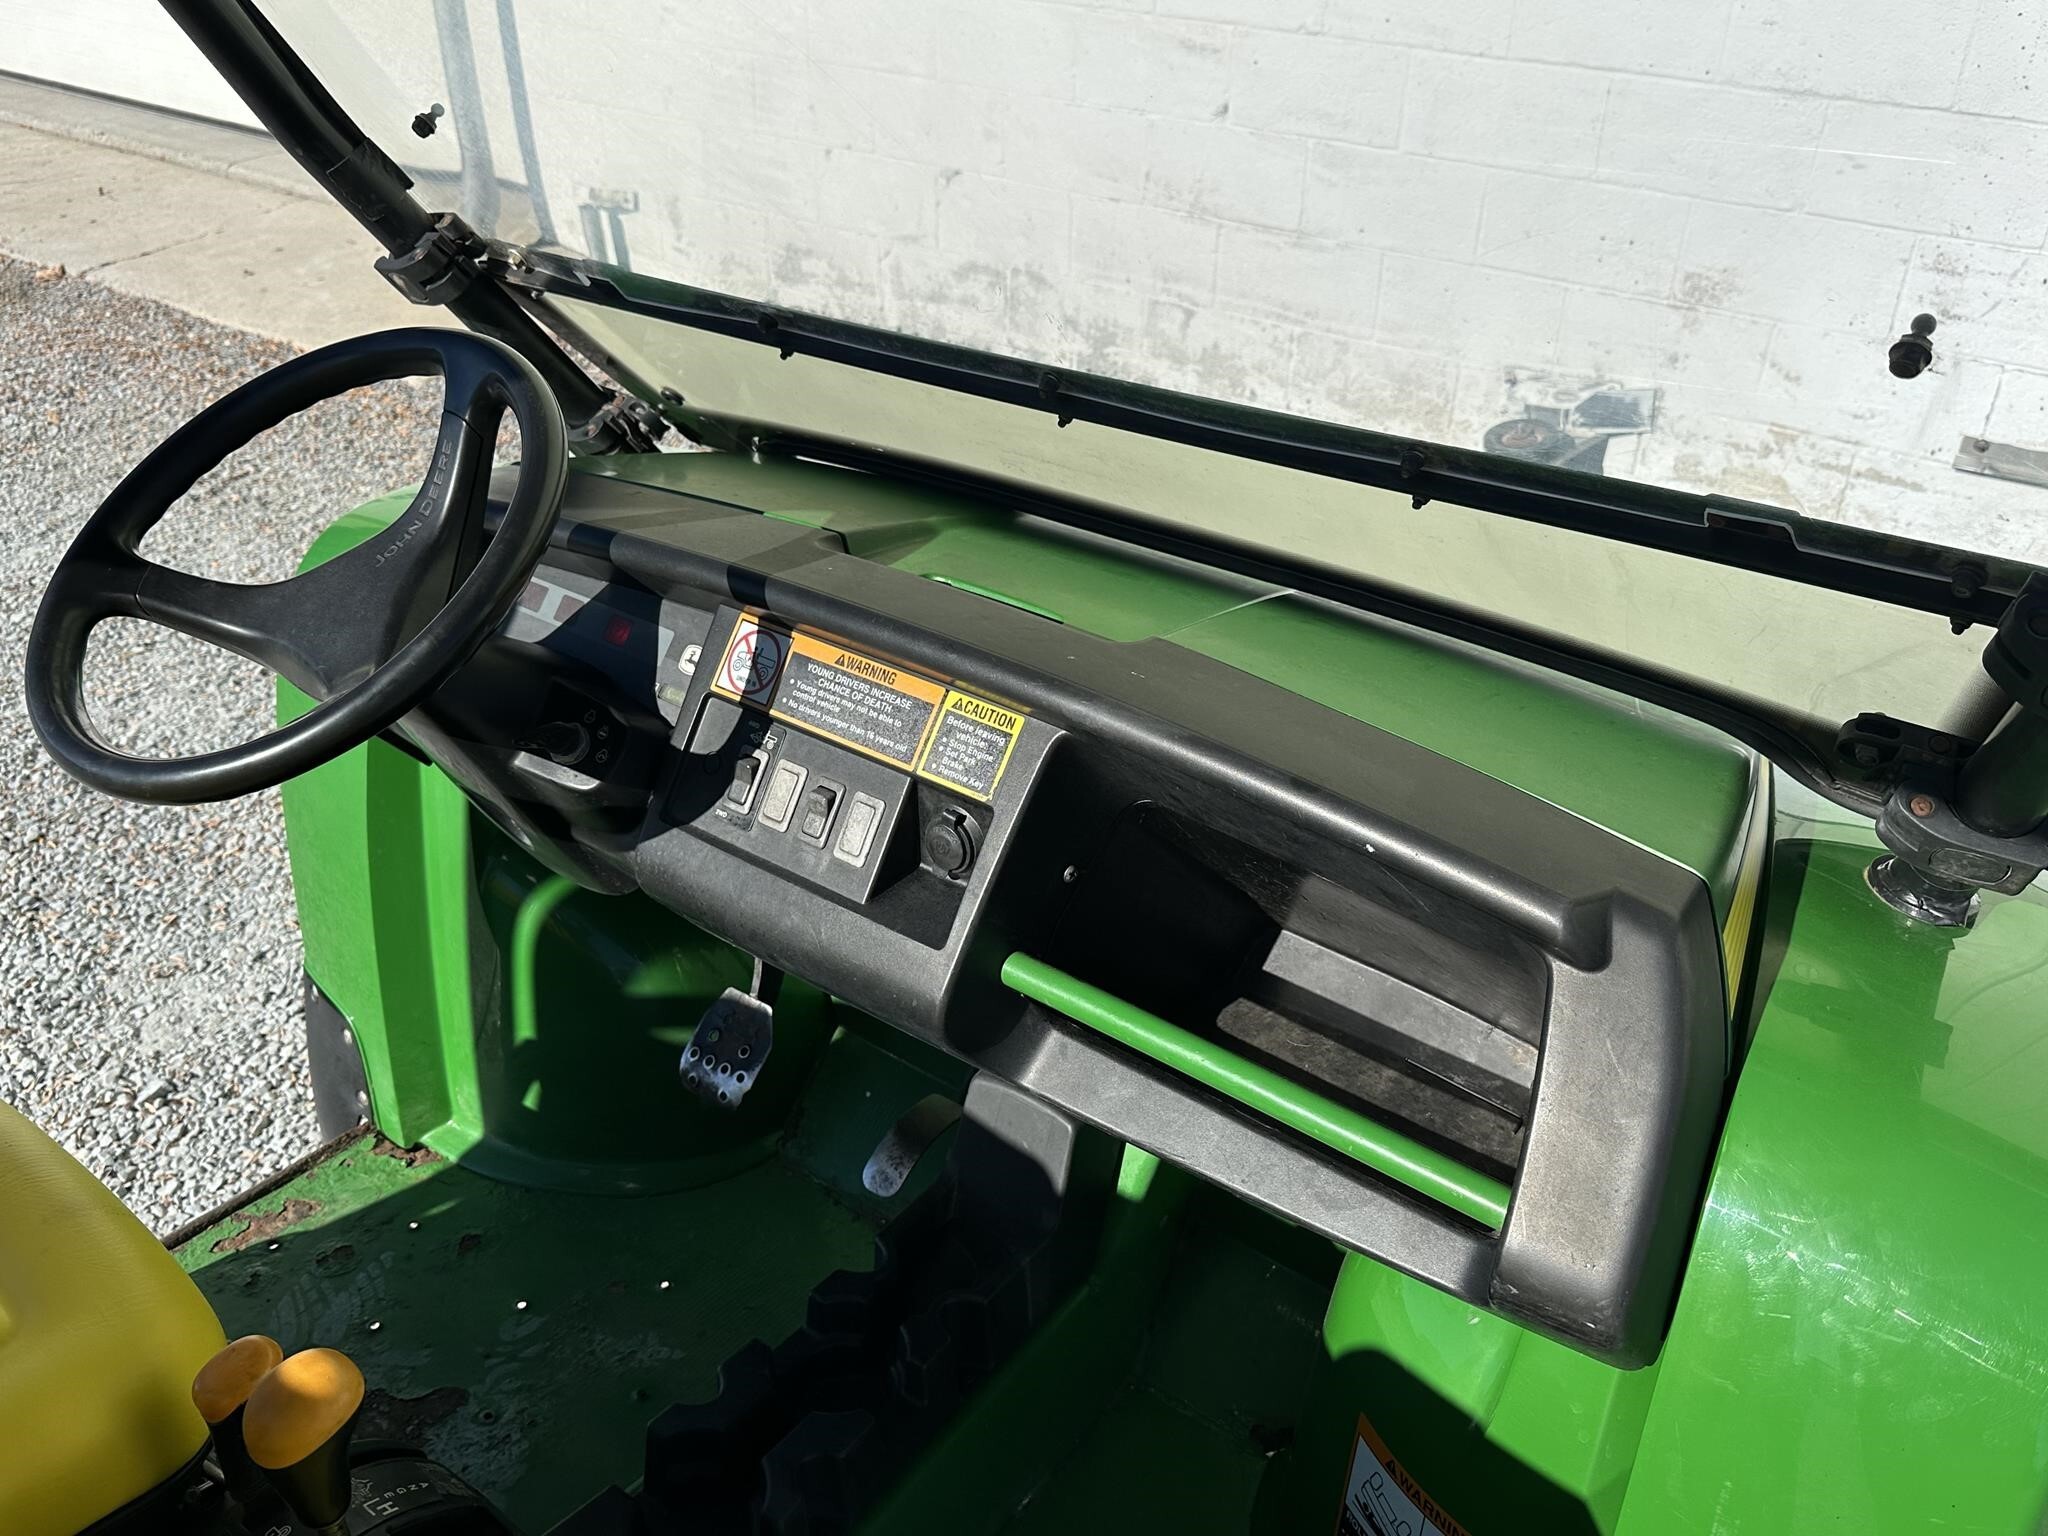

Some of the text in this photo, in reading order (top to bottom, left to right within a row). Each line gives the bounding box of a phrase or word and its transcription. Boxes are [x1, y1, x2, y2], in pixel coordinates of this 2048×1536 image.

[376, 439, 452, 567] JOHN DEERE
[807, 662, 913, 710] YOUNG DRIVERS INCREASE
[846, 656, 897, 686] WARNING
[792, 690, 841, 713] control vehicle
[796, 680, 902, 728] Young drivers may not be able to
[817, 678, 893, 713] CHANCE OF DEATH
[788, 698, 908, 753] No drivers younger than 16 years old
[947, 715, 1006, 747] Before leaving
[963, 700, 1017, 731] CAUTION
[941, 756, 964, 771] Brake
[945, 747, 977, 766] Set Park
[948, 739, 994, 763] Stop Engine
[938, 765, 984, 791] Remove Key
